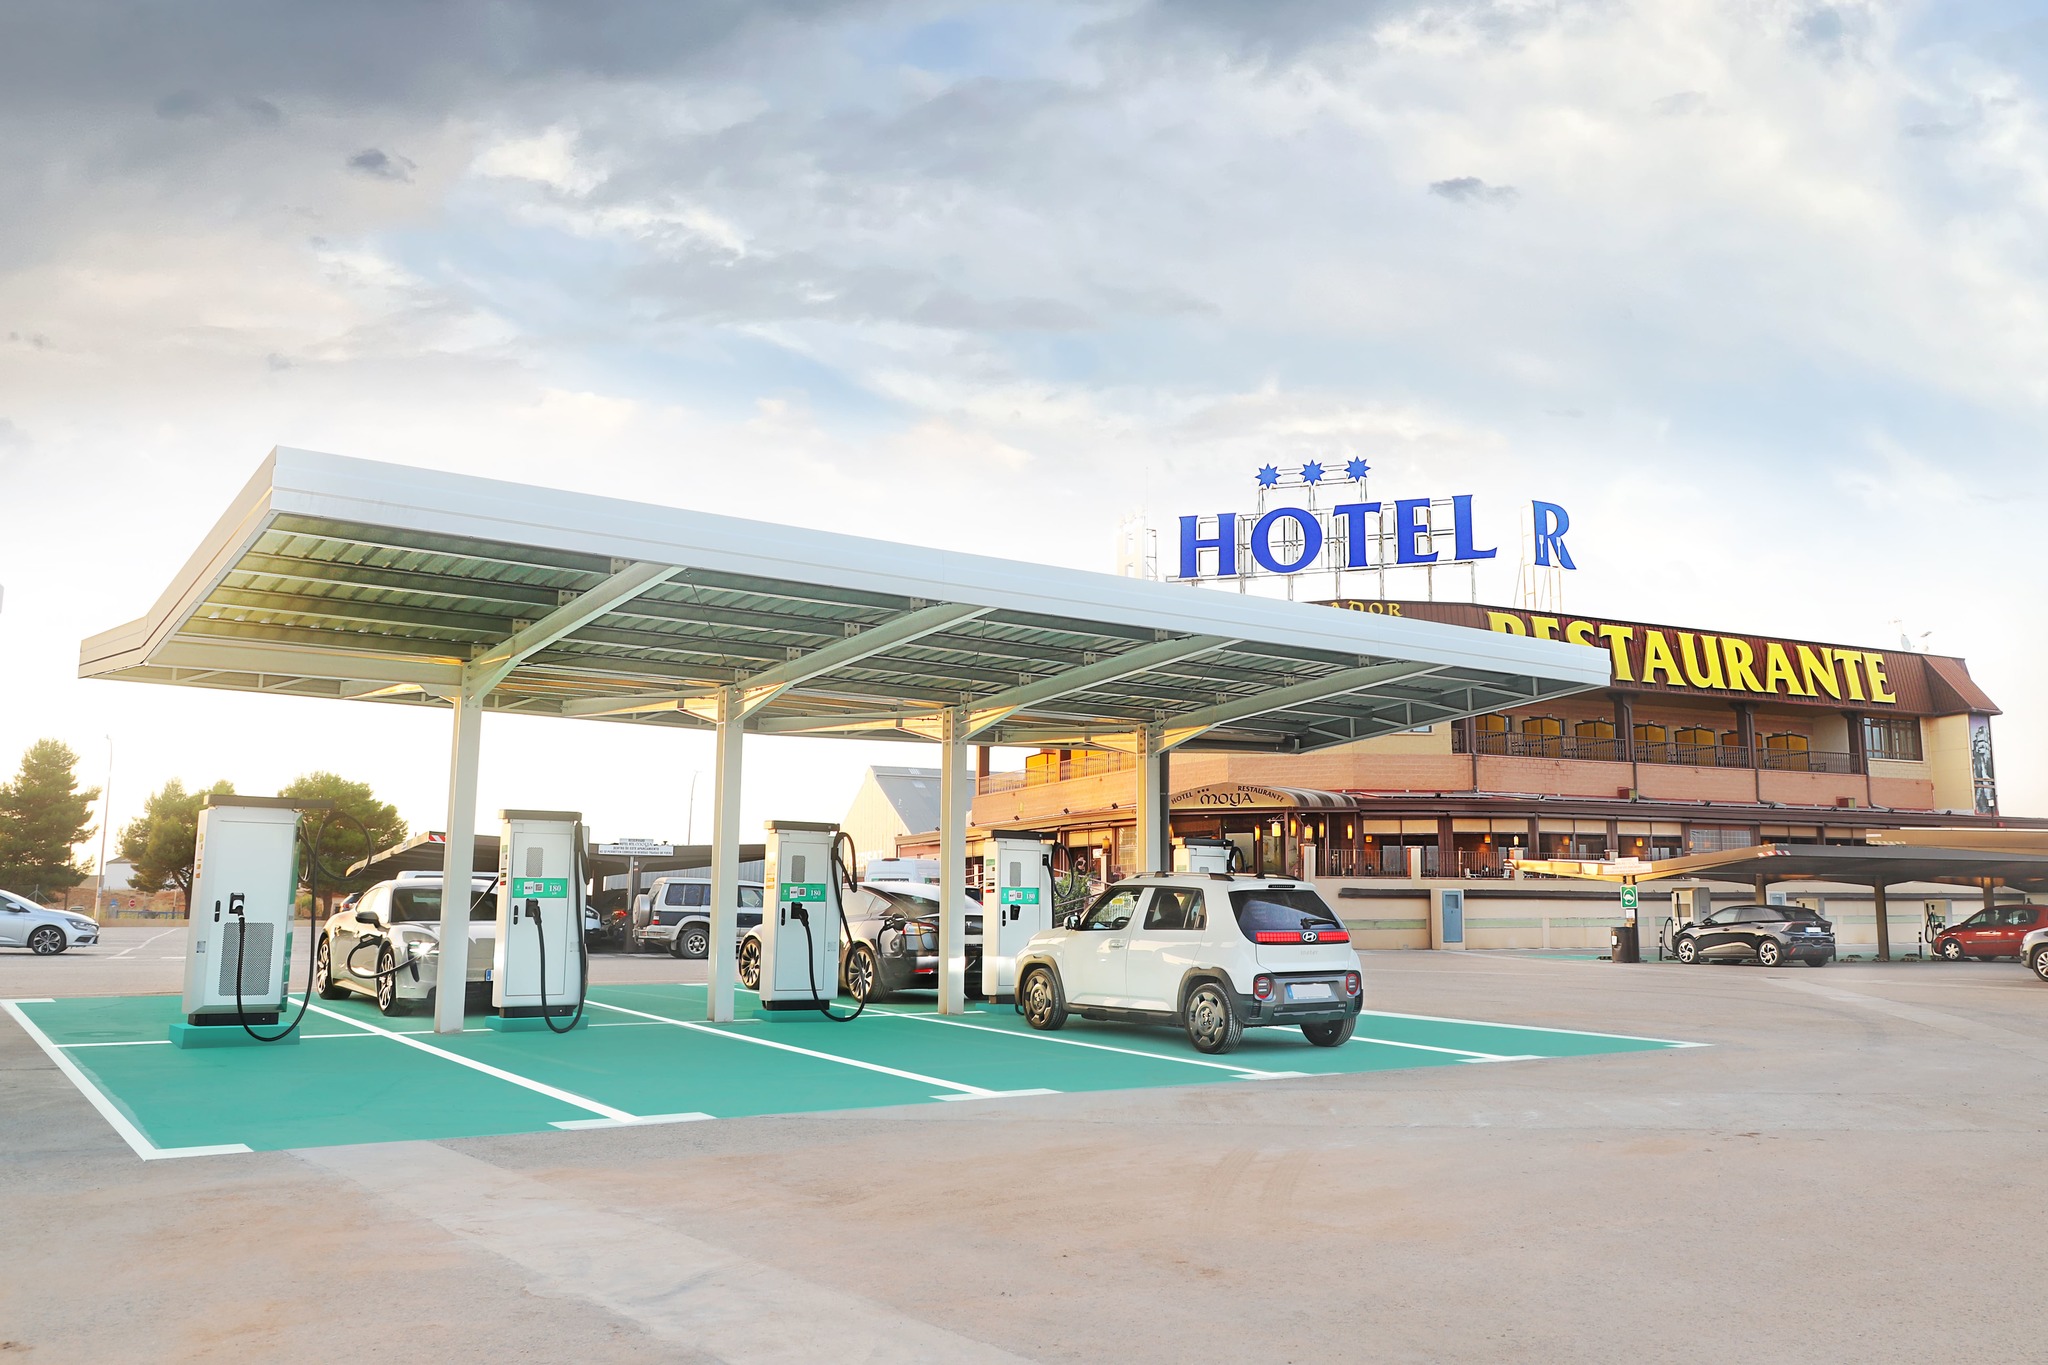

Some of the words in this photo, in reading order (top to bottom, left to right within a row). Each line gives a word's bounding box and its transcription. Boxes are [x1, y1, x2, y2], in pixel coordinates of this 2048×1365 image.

[1178, 494, 1498, 578] HOTEL
[1531, 499, 1577, 571] R
[1171, 792, 1193, 805] HOTEL
[1237, 785, 1285, 803] RESTAURANTE
[549, 884, 562, 892] 180
